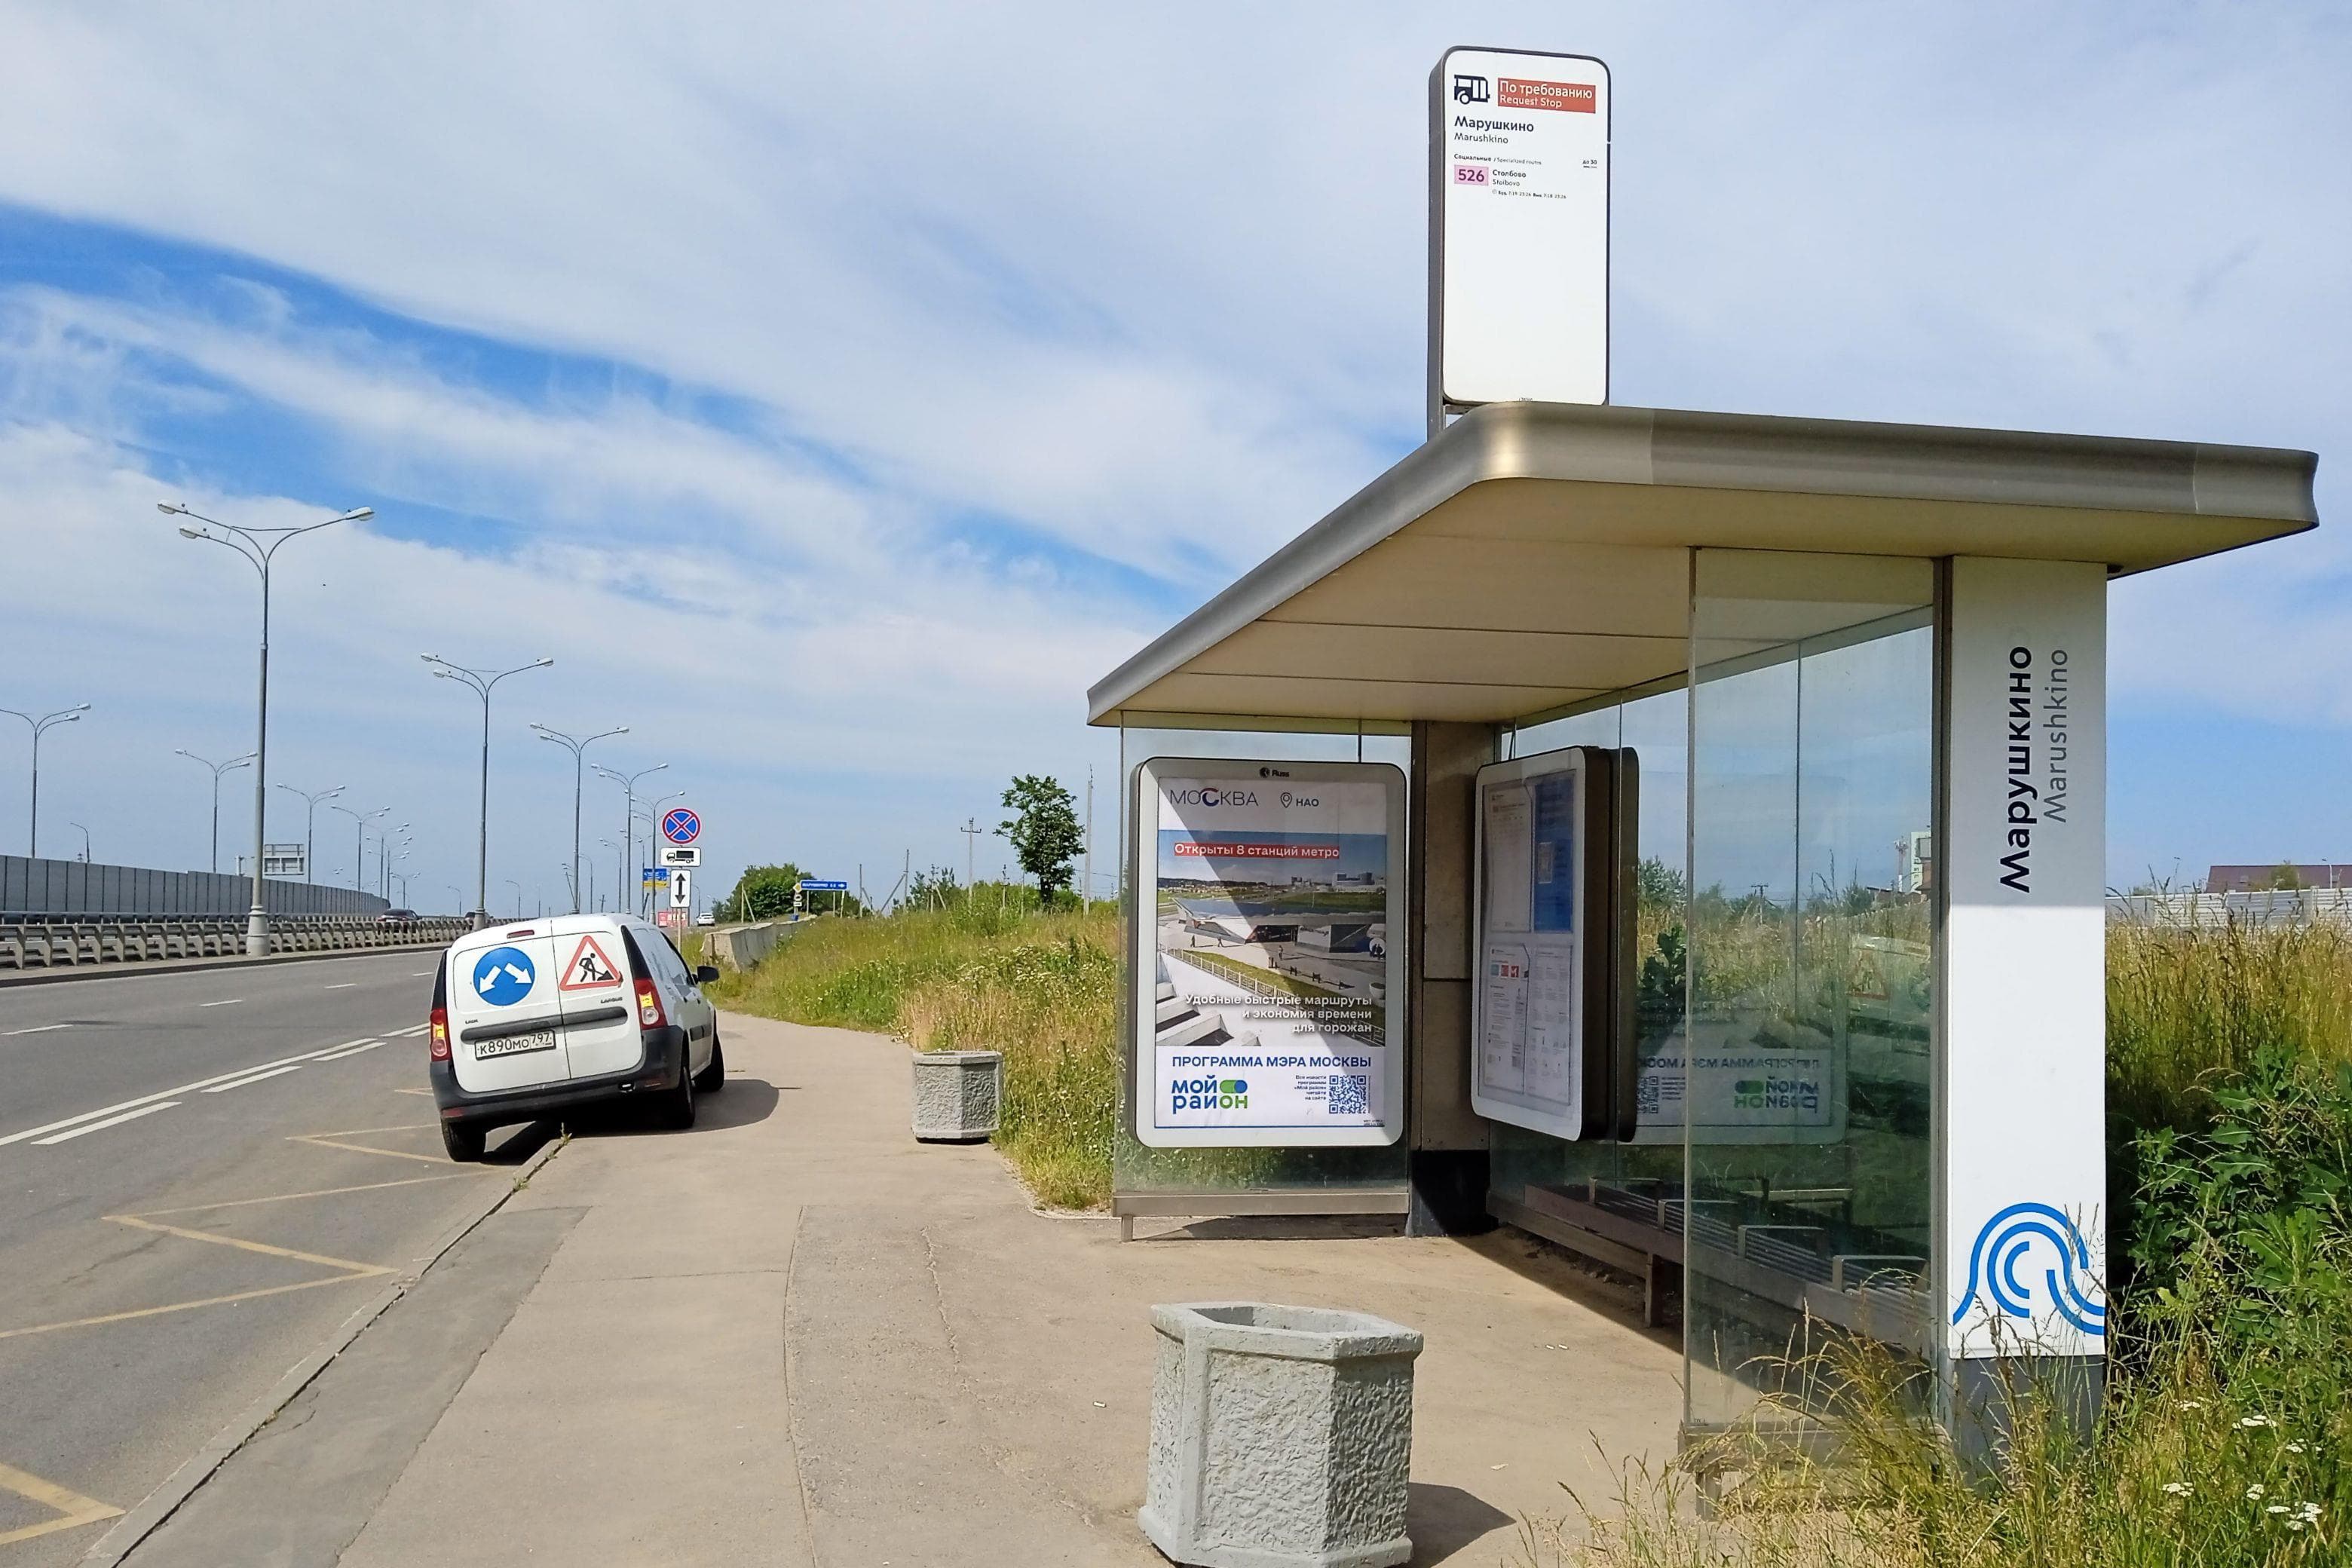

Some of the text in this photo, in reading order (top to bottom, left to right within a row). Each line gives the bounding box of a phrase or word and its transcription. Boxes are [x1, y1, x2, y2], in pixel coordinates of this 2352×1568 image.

[1499, 80, 1593, 100] По требованию
[1499, 96, 1562, 109] Request Stop
[1454, 115, 1534, 132] Марушкино
[1454, 133, 1508, 144] Marushkino
[1453, 153, 1492, 162] Социальные
[1458, 169, 1485, 182] 526
[1493, 170, 1527, 178] Столбово
[2043, 649, 2068, 823] Marushkino
[2000, 646, 2038, 893] Марушкино
[1170, 788, 1258, 807] МОСКВА
[1296, 798, 1319, 807] НАО
[1174, 844, 1340, 858] Открыты 8 станций метро
[1186, 994, 1372, 1007] Удобные быстрые маршруты
[1242, 1009, 1372, 1019] и экономия времени
[1293, 1024, 1372, 1034] для горожан
[1172, 1056, 1371, 1067] ПРОГРАММА МЭРА МОСКВЫ
